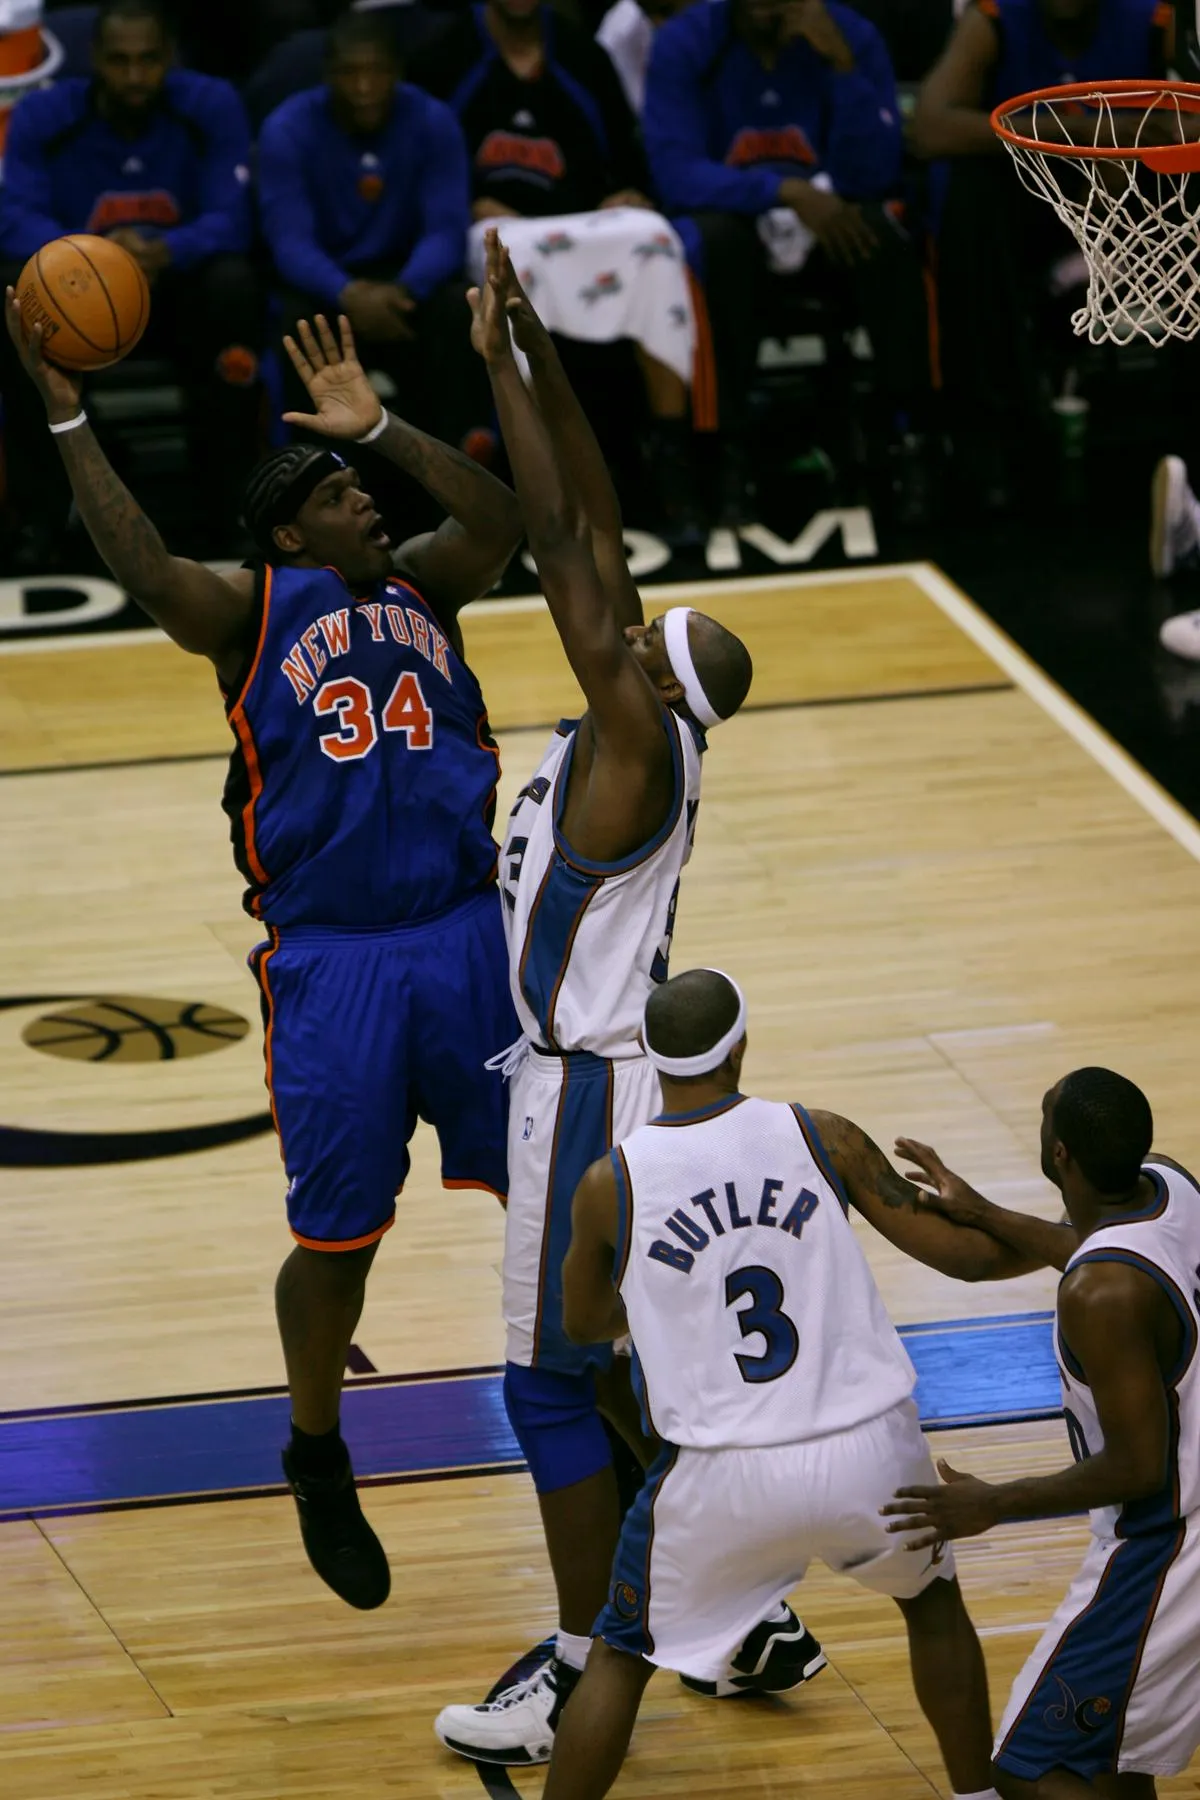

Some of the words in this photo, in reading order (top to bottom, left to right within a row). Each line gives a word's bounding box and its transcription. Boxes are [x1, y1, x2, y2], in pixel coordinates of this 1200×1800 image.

[280, 608, 350, 707] NEW
[355, 603, 453, 686] YORK
[312, 671, 434, 763] 34
[648, 1178, 819, 1275] BUTLER
[724, 1265, 799, 1384] 3
